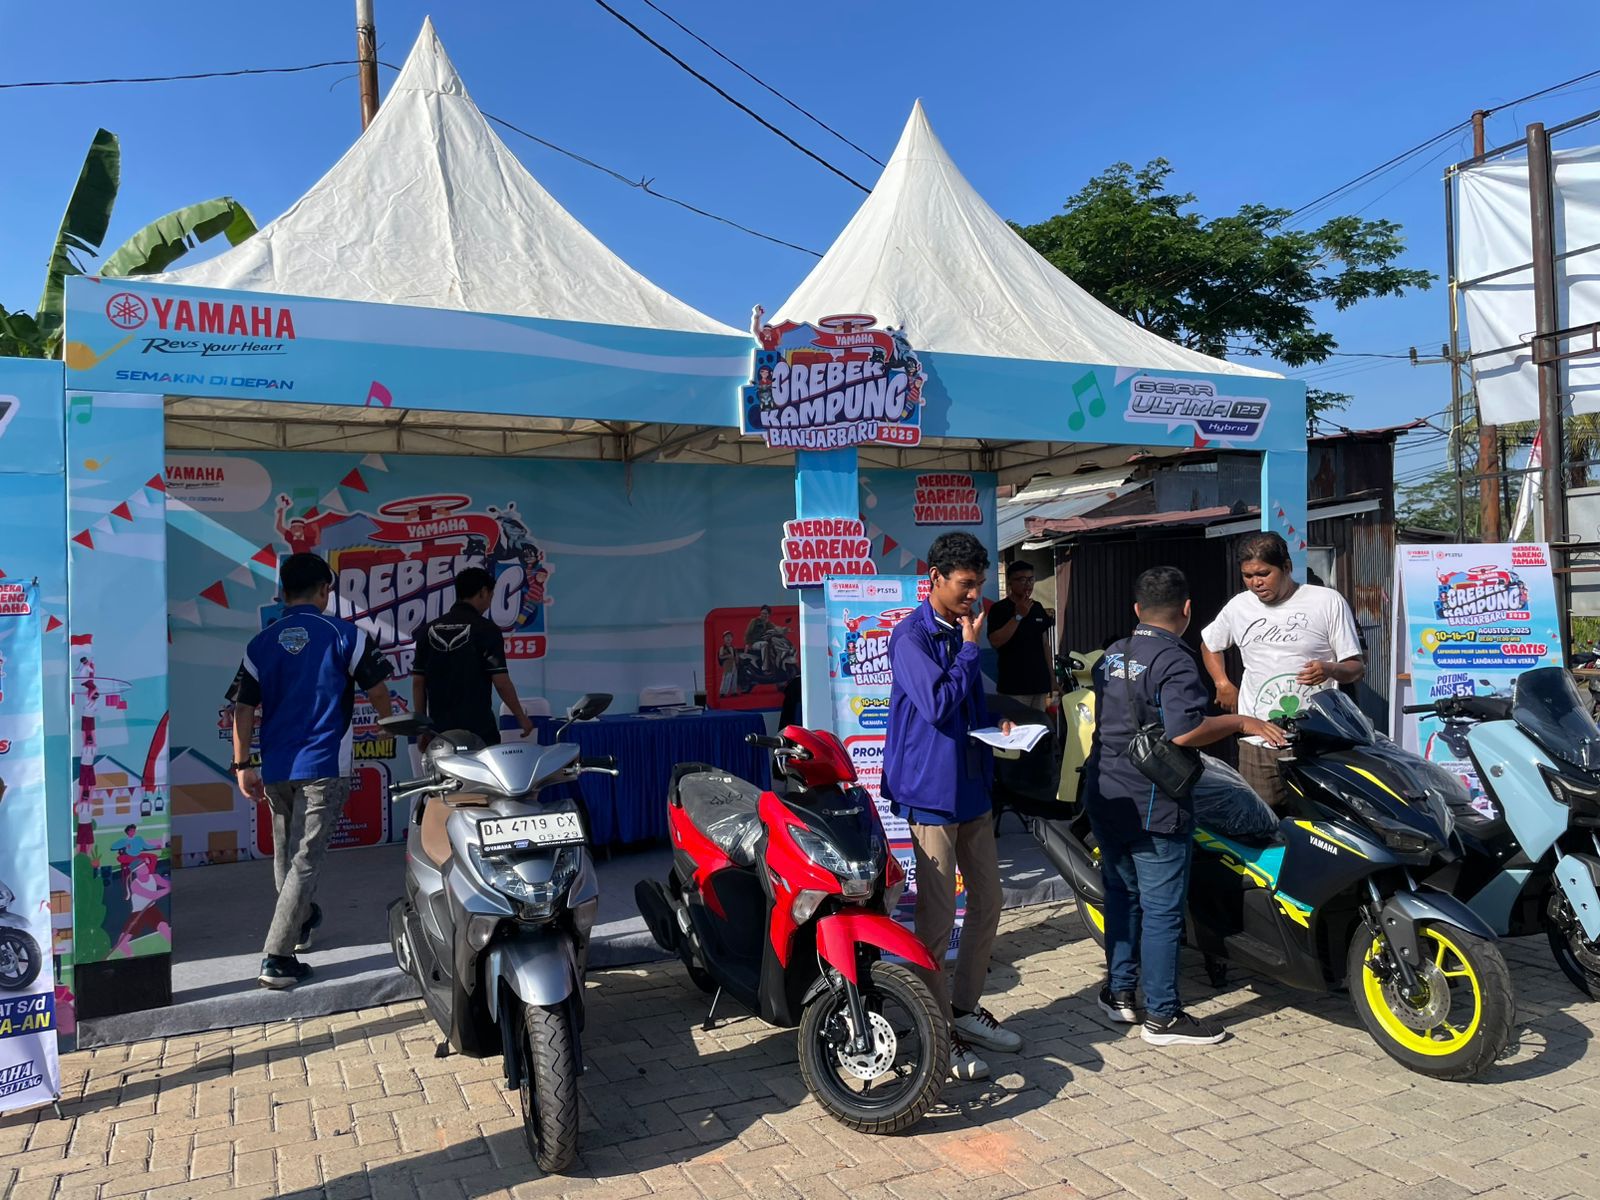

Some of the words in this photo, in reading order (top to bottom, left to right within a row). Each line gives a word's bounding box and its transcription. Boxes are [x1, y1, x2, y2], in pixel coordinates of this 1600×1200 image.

[151, 297, 295, 340] YAMAHA
[140, 338, 199, 354] Revs
[201, 342, 240, 356] your
[240, 341, 284, 352] Heart
[835, 334, 875, 346] YAMAHA
[116, 370, 204, 385] SEMAKIN
[230, 376, 294, 390] DEPAN
[771, 361, 885, 406] GREBEK
[1134, 381, 1213, 396] GEAR
[760, 373, 908, 427] KAMPUNG
[1132, 395, 1233, 418] ULTIMA
[1235, 404, 1261, 415] 125
[768, 422, 878, 448] BANJARBARU
[881, 428, 913, 440] 2025
[1208, 423, 1248, 432] Hybrid
[165, 466, 224, 481] YAMAHA
[917, 475, 971, 488] MERDEKA
[917, 488, 976, 504] BARENG
[914, 505, 981, 521] YAMAHA
[407, 518, 469, 538] YAMAHA
[788, 520, 862, 537] MERDEKA
[786, 539, 869, 560] BARENG
[785, 560, 875, 582] YAMAHA
[329, 555, 486, 620] REBEK
[1447, 584, 1505, 608] GREBEK
[1443, 588, 1519, 618] KAMPUNG
[1449, 611, 1506, 626] BANJARBARU
[1239, 618, 1298, 648] Celtics
[503, 640, 536, 654] 025
[1502, 644, 1546, 654] GRATIS
[1437, 673, 1468, 685] POTONG
[853, 747, 885, 757] PROM
[483, 823, 503, 836] DA
[512, 819, 547, 832] 4719
[556, 815, 576, 828] CX
[1310, 836, 1338, 855] YAMAHA
[17, 995, 46, 1014] S/d
[0, 1011, 51, 1035] A-AN
[0, 1075, 42, 1097] SELTENG
